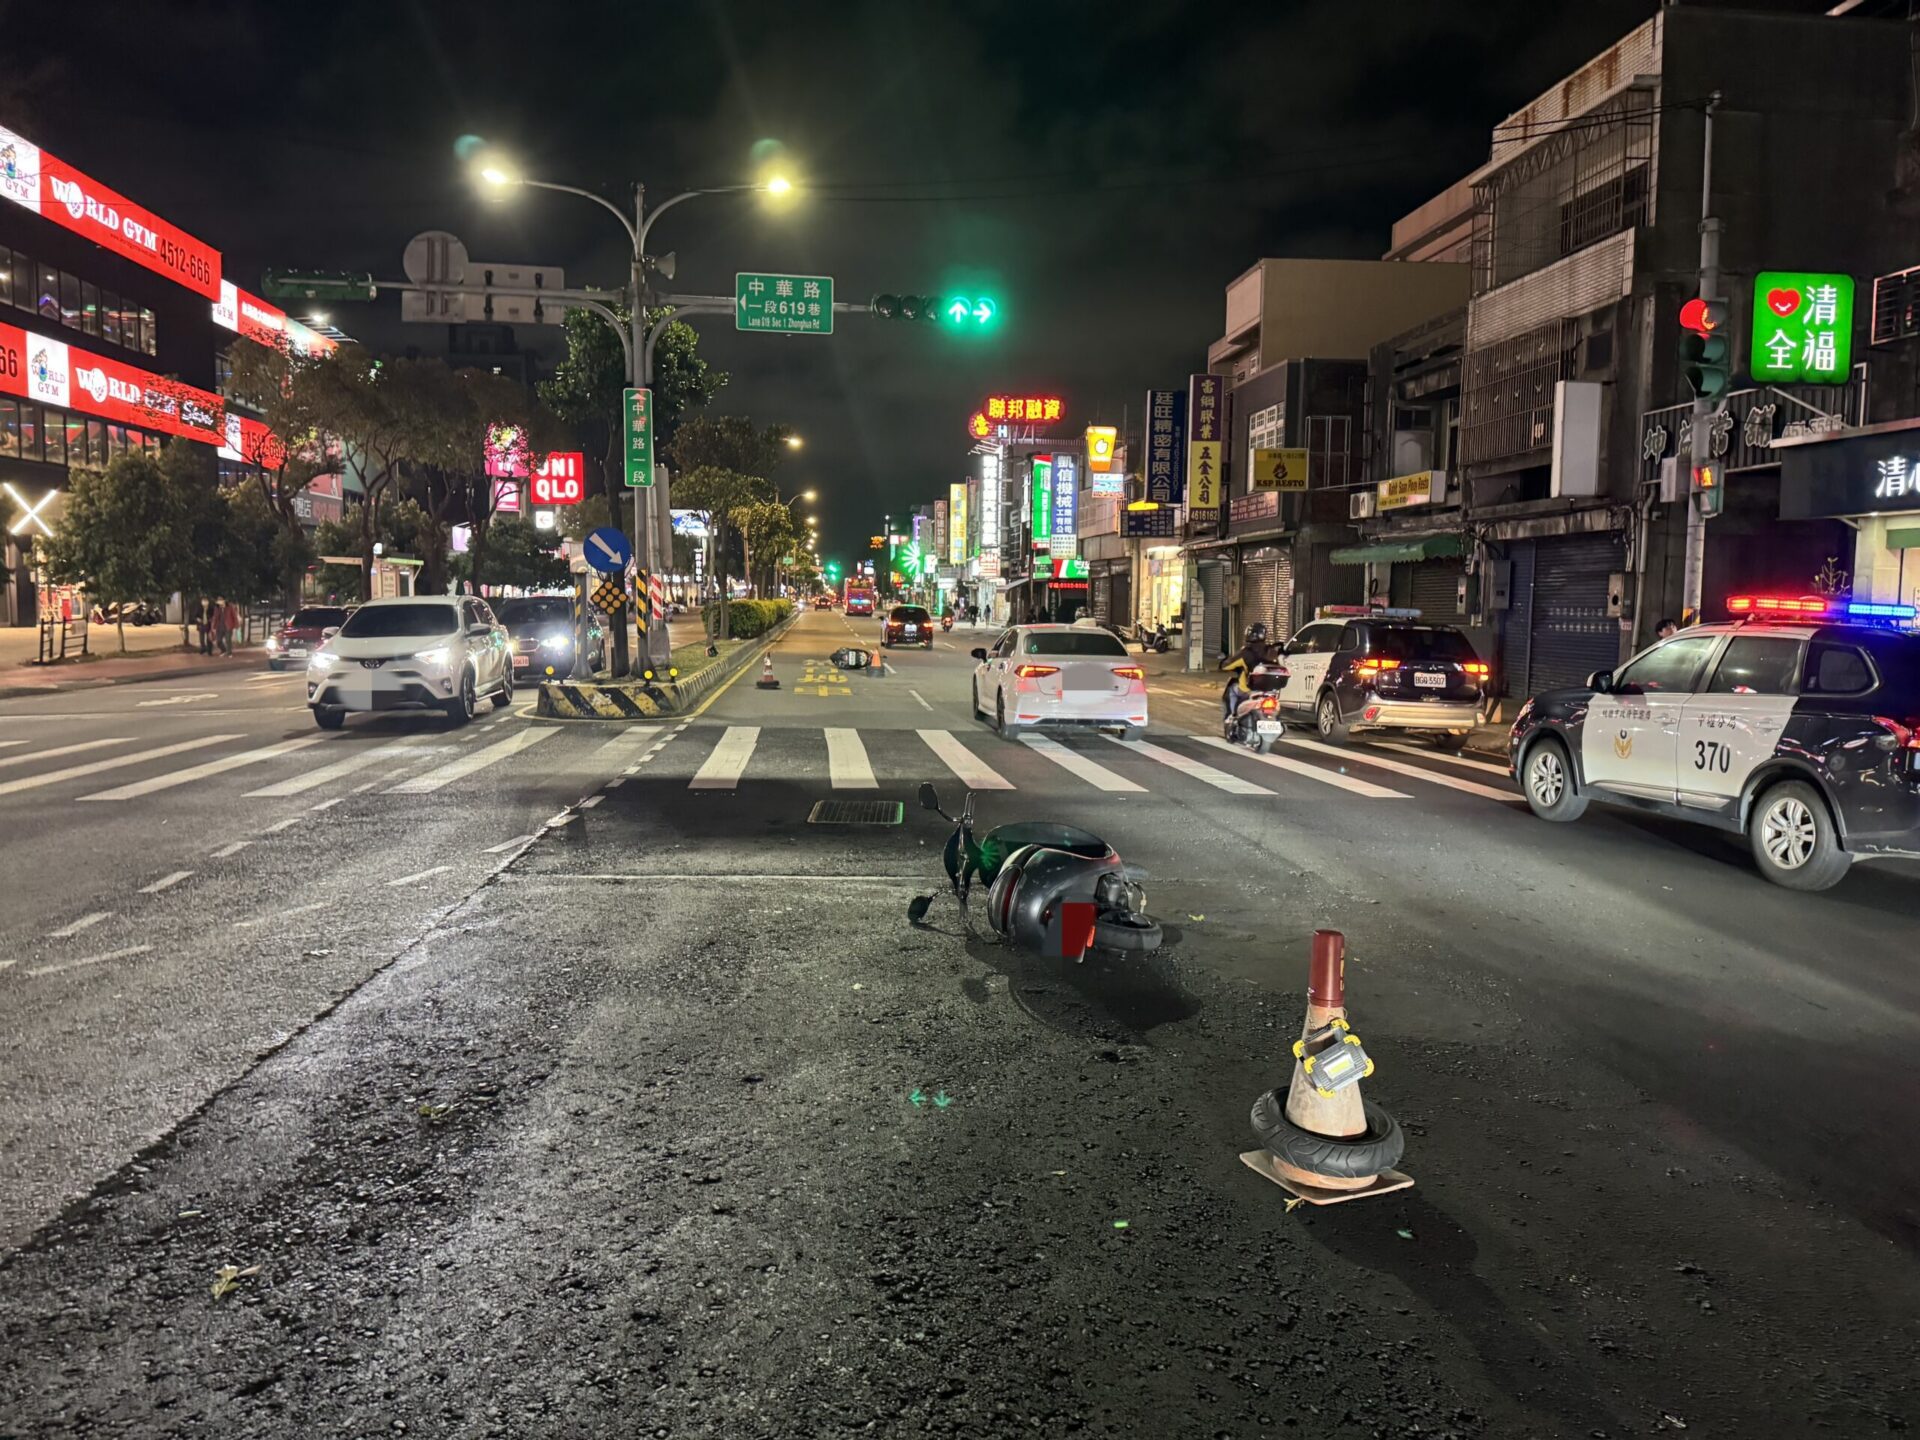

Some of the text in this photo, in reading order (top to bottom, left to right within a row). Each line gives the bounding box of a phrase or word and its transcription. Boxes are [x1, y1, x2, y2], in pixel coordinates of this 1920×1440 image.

[5, 178, 29, 199] GYM
[50, 176, 119, 230] WORLD
[123, 217, 158, 252] GYM
[160, 238, 210, 286] 4512-666
[748, 278, 820, 299] 中華路
[748, 300, 820, 316] 一段619巷
[1802, 284, 1837, 326] 清
[38, 382, 59, 396] GYM
[75, 367, 141, 404] WORLD
[988, 398, 1060, 420] 聯邦融資
[632, 402, 646, 484] 中華路一段
[1198, 446, 1213, 505] 五金公司
[1256, 479, 1305, 488] KSP RESTO
[536, 479, 579, 501] QLO
[1694, 740, 1731, 774] 370
